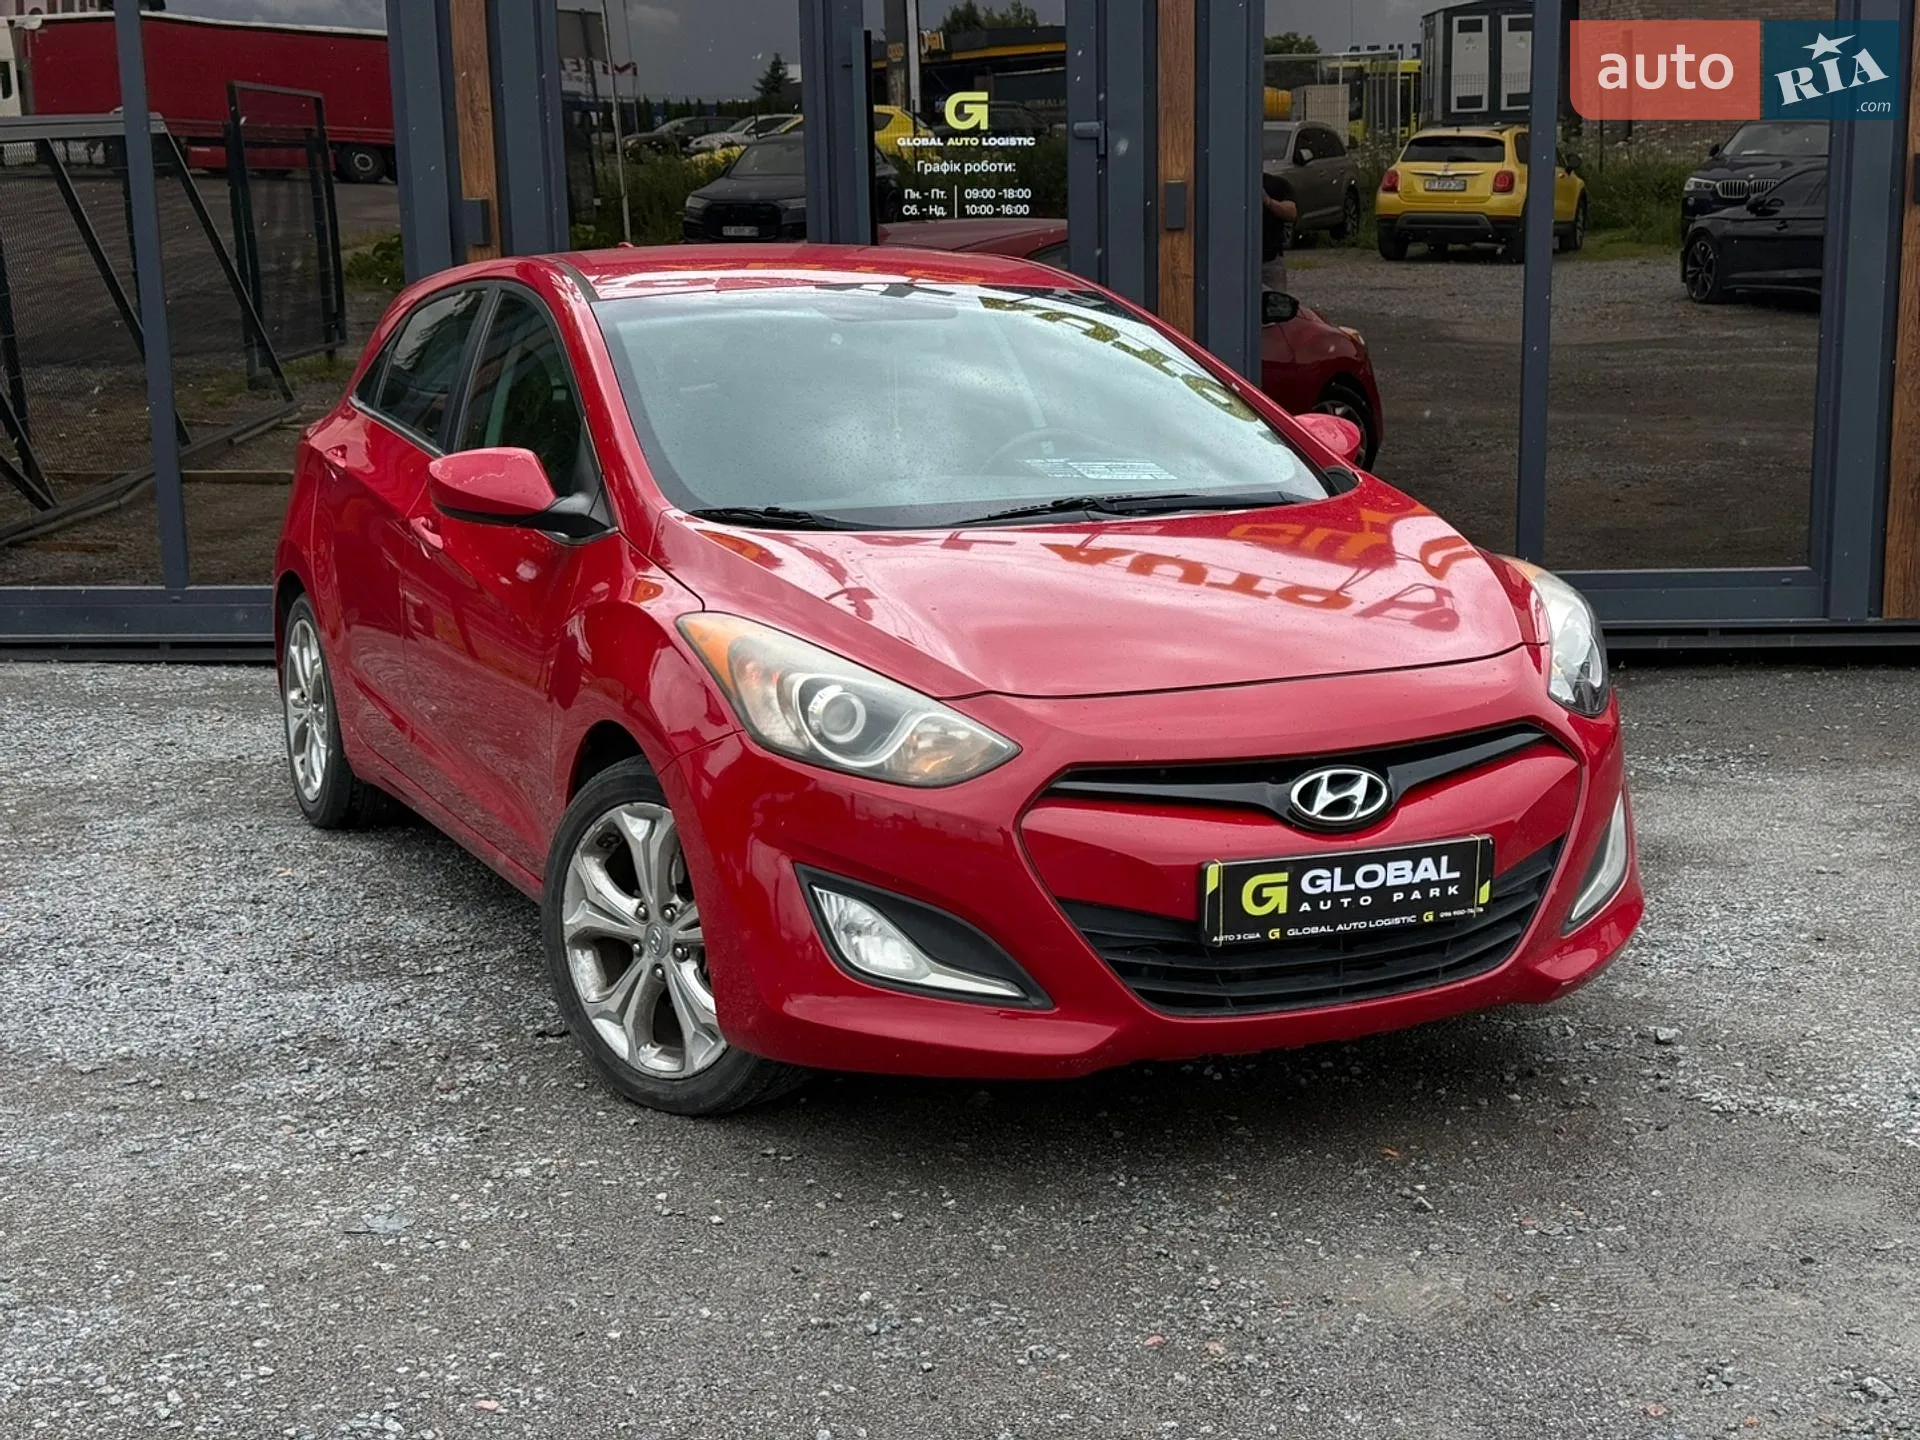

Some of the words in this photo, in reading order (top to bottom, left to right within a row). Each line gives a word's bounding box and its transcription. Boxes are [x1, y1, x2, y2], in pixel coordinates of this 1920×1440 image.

[896, 136, 944, 147] GLOBAL
[947, 136, 979, 147] AUTO
[982, 136, 1036, 147] LOGISTIC
[916, 160, 961, 175] Графік
[964, 160, 1017, 175] роботи:
[904, 188, 922, 200] Пн.
[931, 188, 948, 200] Пт.
[902, 204, 921, 216] Сб.
[929, 204, 948, 217] Нд.
[1300, 855, 1460, 895] GLOBAL
[1299, 896, 1372, 912] AUTO
[1393, 884, 1460, 902] PARK
[1286, 925, 1334, 936] GLOBAL
[1336, 920, 1367, 931] AUTO
[1369, 915, 1417, 927] LOGISTIC
